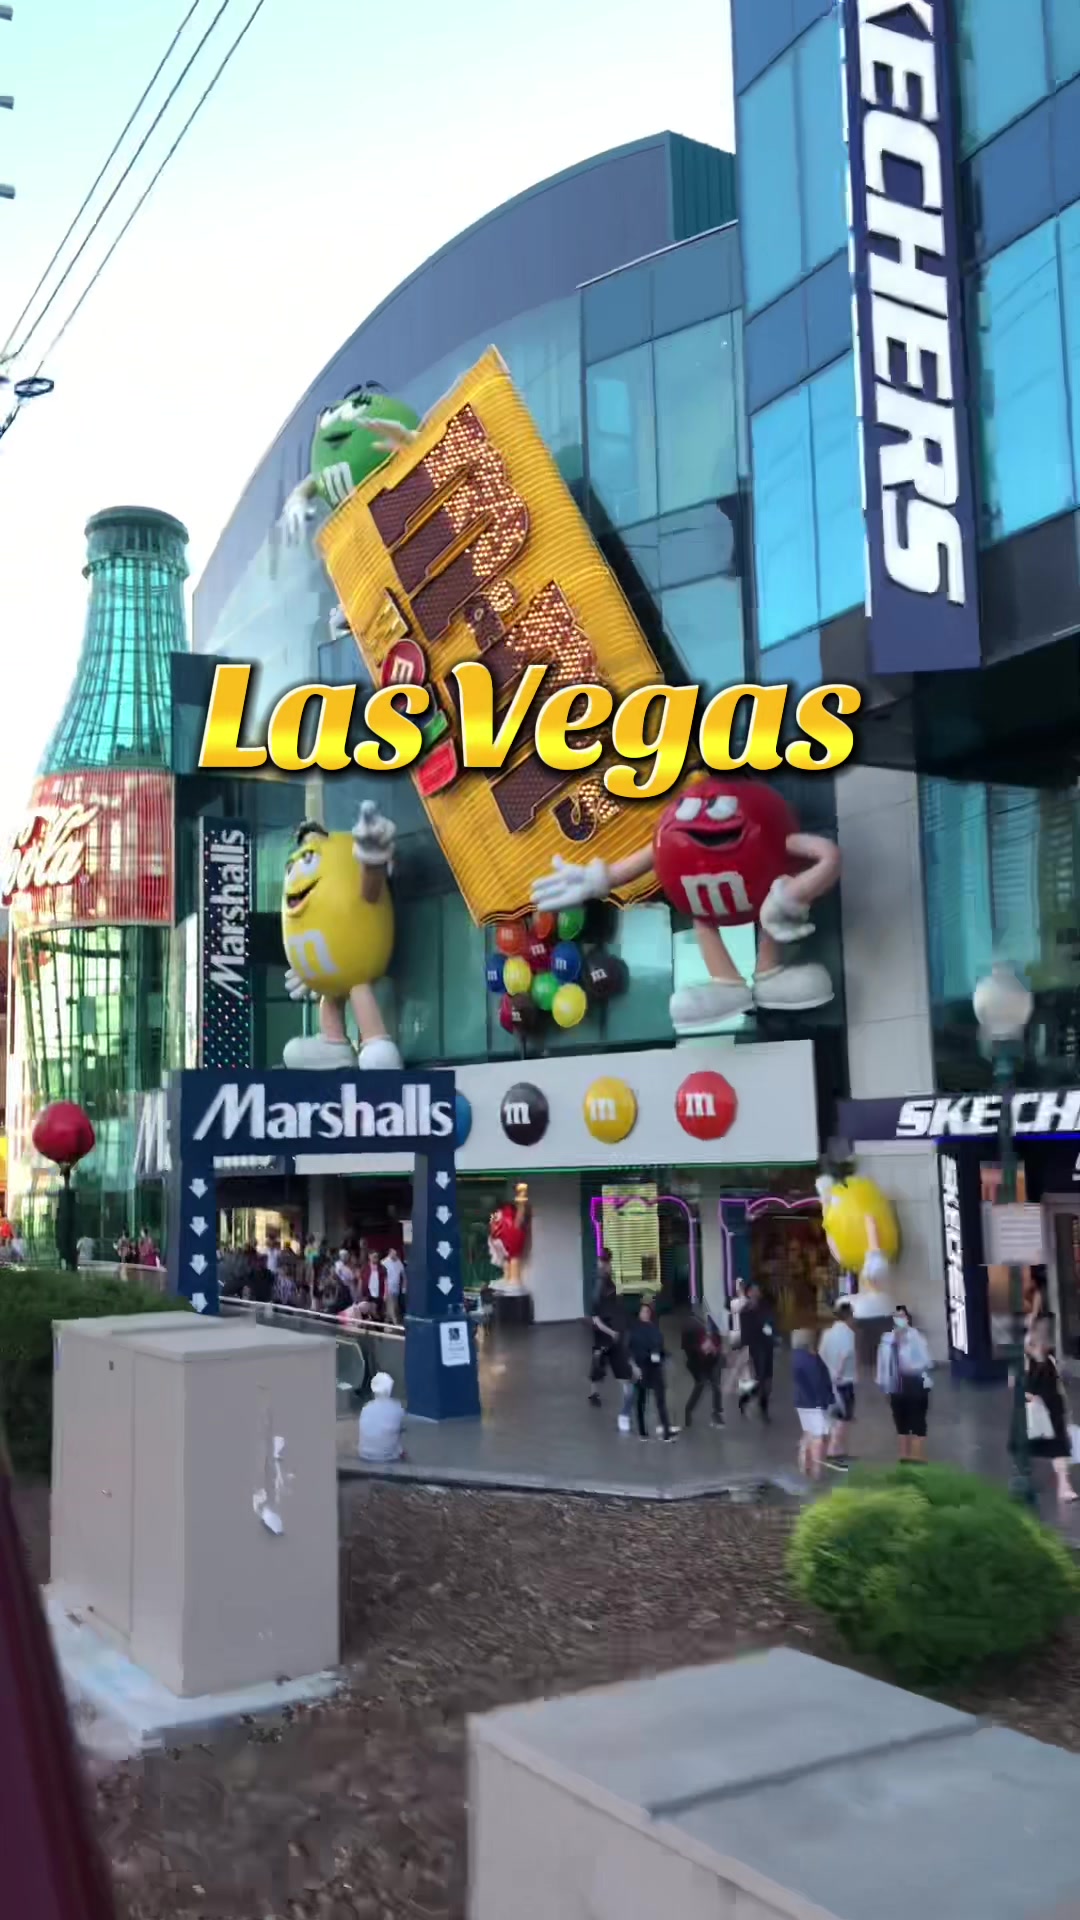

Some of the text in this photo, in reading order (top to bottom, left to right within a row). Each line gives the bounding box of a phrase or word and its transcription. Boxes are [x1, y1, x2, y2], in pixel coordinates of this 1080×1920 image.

[210, 829, 245, 1000] Marshalls
[680, 871, 753, 917] m
[192, 1083, 454, 1141] Marshalls
[504, 1101, 531, 1125] m
[588, 1097, 617, 1121] m
[683, 1092, 717, 1118] m
[896, 1089, 1080, 1137] SKECH
